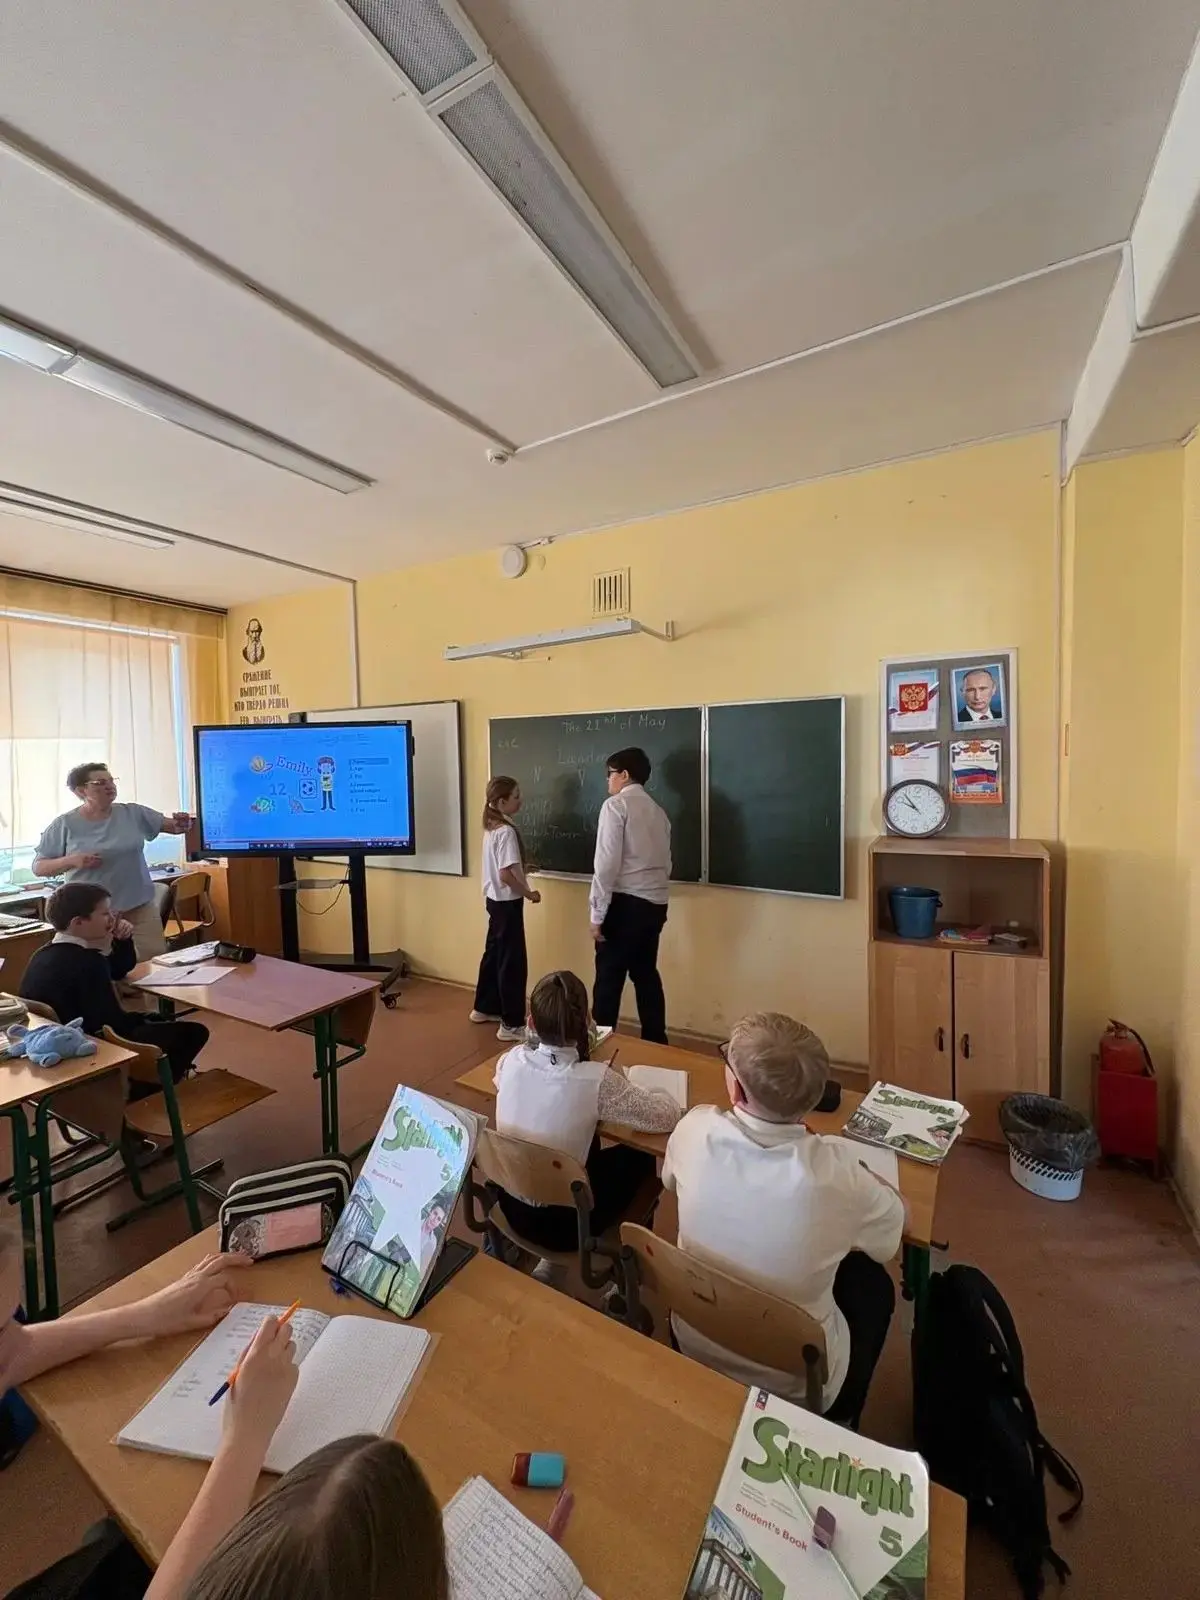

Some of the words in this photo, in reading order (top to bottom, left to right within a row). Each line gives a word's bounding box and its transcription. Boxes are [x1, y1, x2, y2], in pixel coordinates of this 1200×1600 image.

[639, 712, 667, 732] May
[276, 755, 313, 777] Emily
[269, 782, 287, 796] 12
[440, 1163, 453, 1181] 5
[741, 1416, 915, 1518] Starlight
[734, 1503, 780, 1535] Student's
[782, 1530, 808, 1552] Book
[879, 1525, 904, 1558] 5
